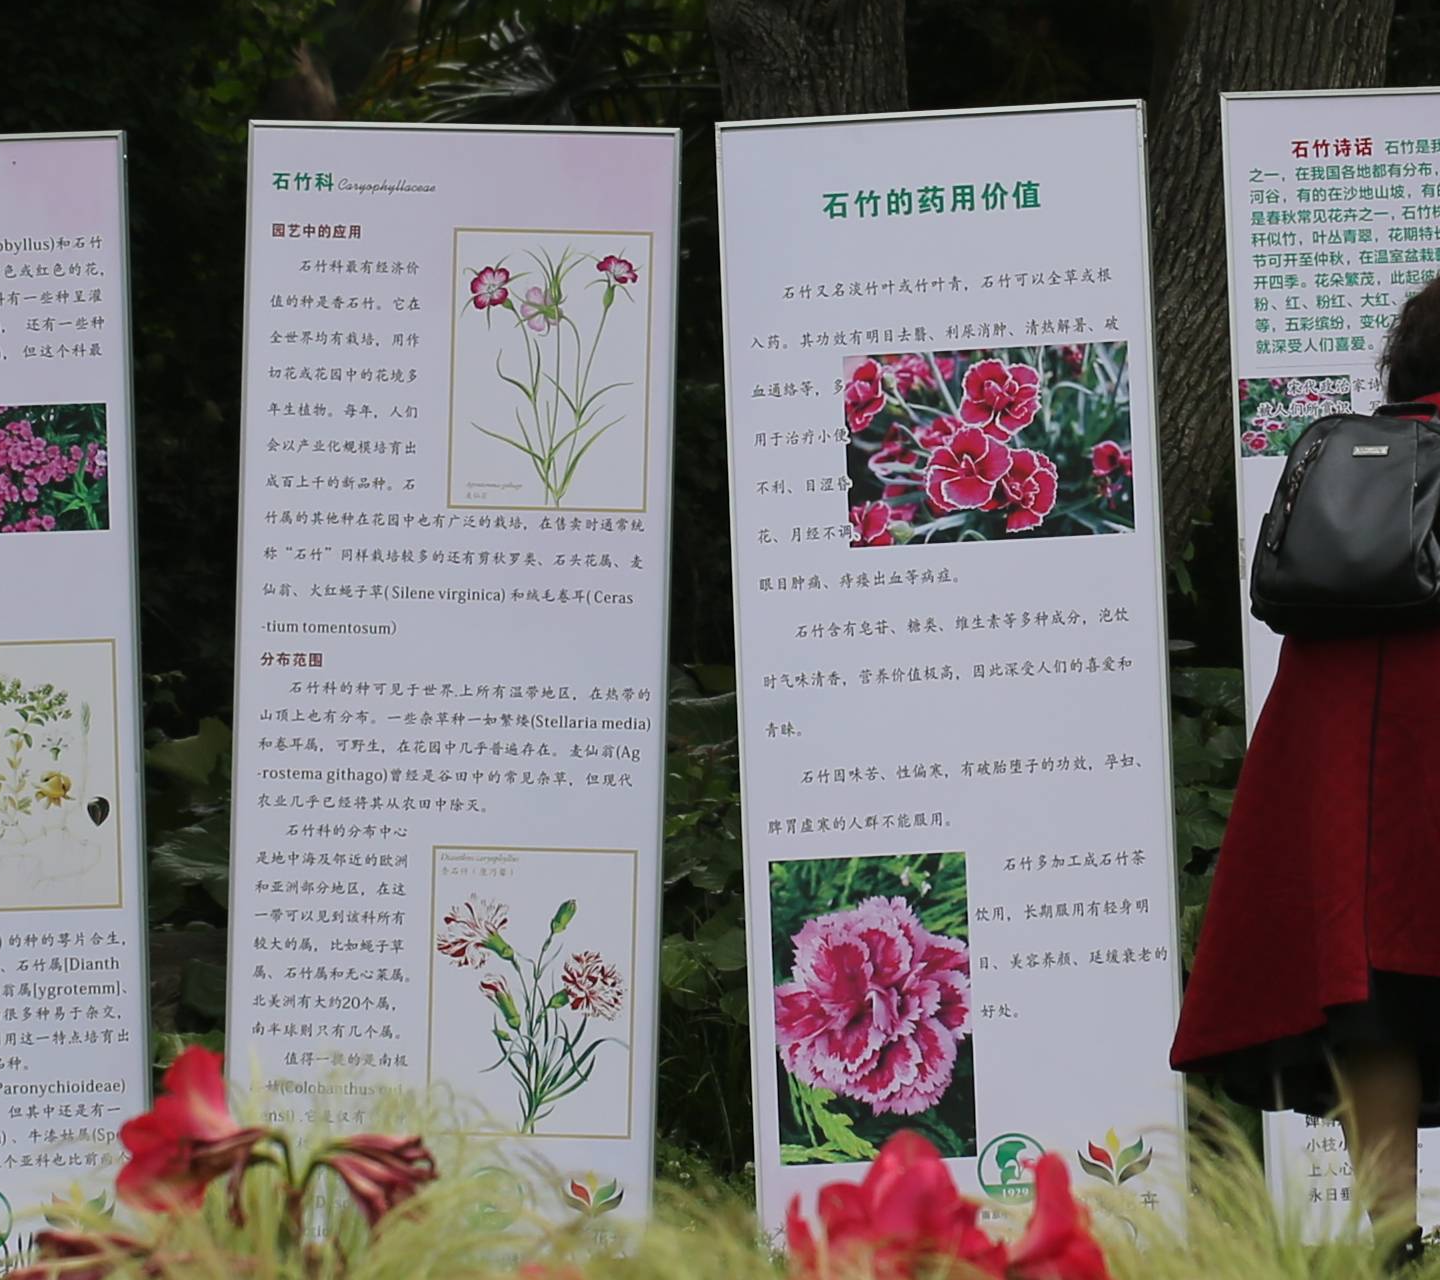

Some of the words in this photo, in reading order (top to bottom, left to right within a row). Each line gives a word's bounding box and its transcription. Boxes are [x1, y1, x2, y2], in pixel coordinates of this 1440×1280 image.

[1291, 138, 1373, 158] 石竹诗话
[272, 172, 334, 191] 石竹科
[338, 178, 436, 195] Caryophyllaceae
[823, 181, 1040, 219] 石竹的药用价值
[272, 223, 361, 239] 园艺中的应用
[299, 260, 419, 275] 石竹科最有经济价
[262, 621, 298, 632] -tium
[261, 652, 322, 667] 分布范围
[602, 717, 650, 731] media)
[258, 769, 322, 780] -rostema
[286, 824, 407, 839] 石竹科的分布中心
[1003, 850, 1146, 871] 石竹多加工成石竹茶
[981, 1004, 1018, 1018] 好处。
